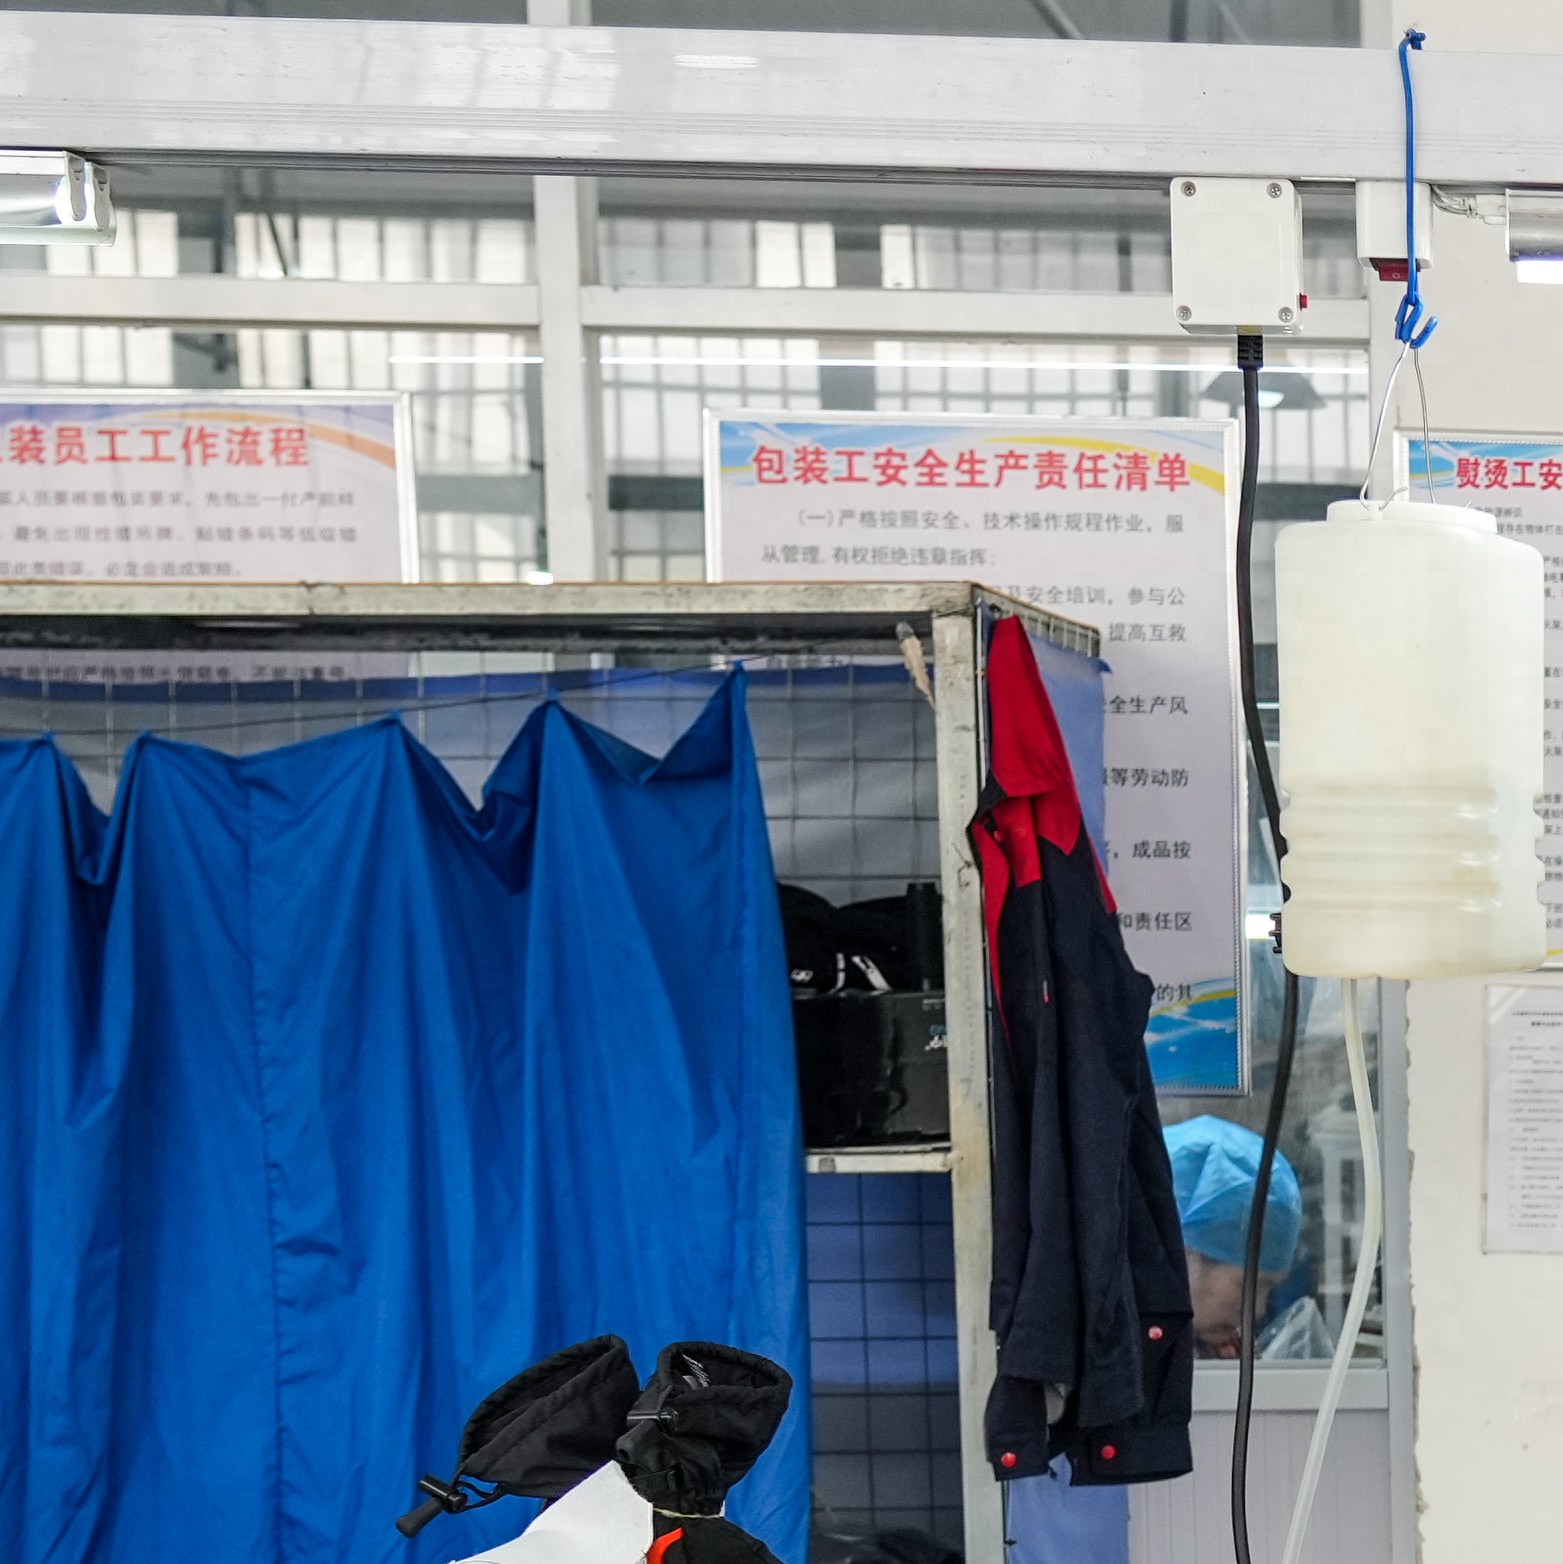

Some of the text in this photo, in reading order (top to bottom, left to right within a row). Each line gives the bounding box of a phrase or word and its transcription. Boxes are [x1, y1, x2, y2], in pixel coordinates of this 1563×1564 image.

[0, 425, 309, 466] 装员工工作流程
[752, 445, 1191, 492] 包装工安全生产责任清单
[997, 585, 1185, 606] 及安全培训，参与公
[1108, 622, 1186, 643] 提高互救
[1103, 696, 1188, 715] 全生产风
[1103, 769, 1188, 787] 等劳动防
[1105, 841, 1190, 859] ，成品按
[1152, 983, 1193, 1002] 的其
